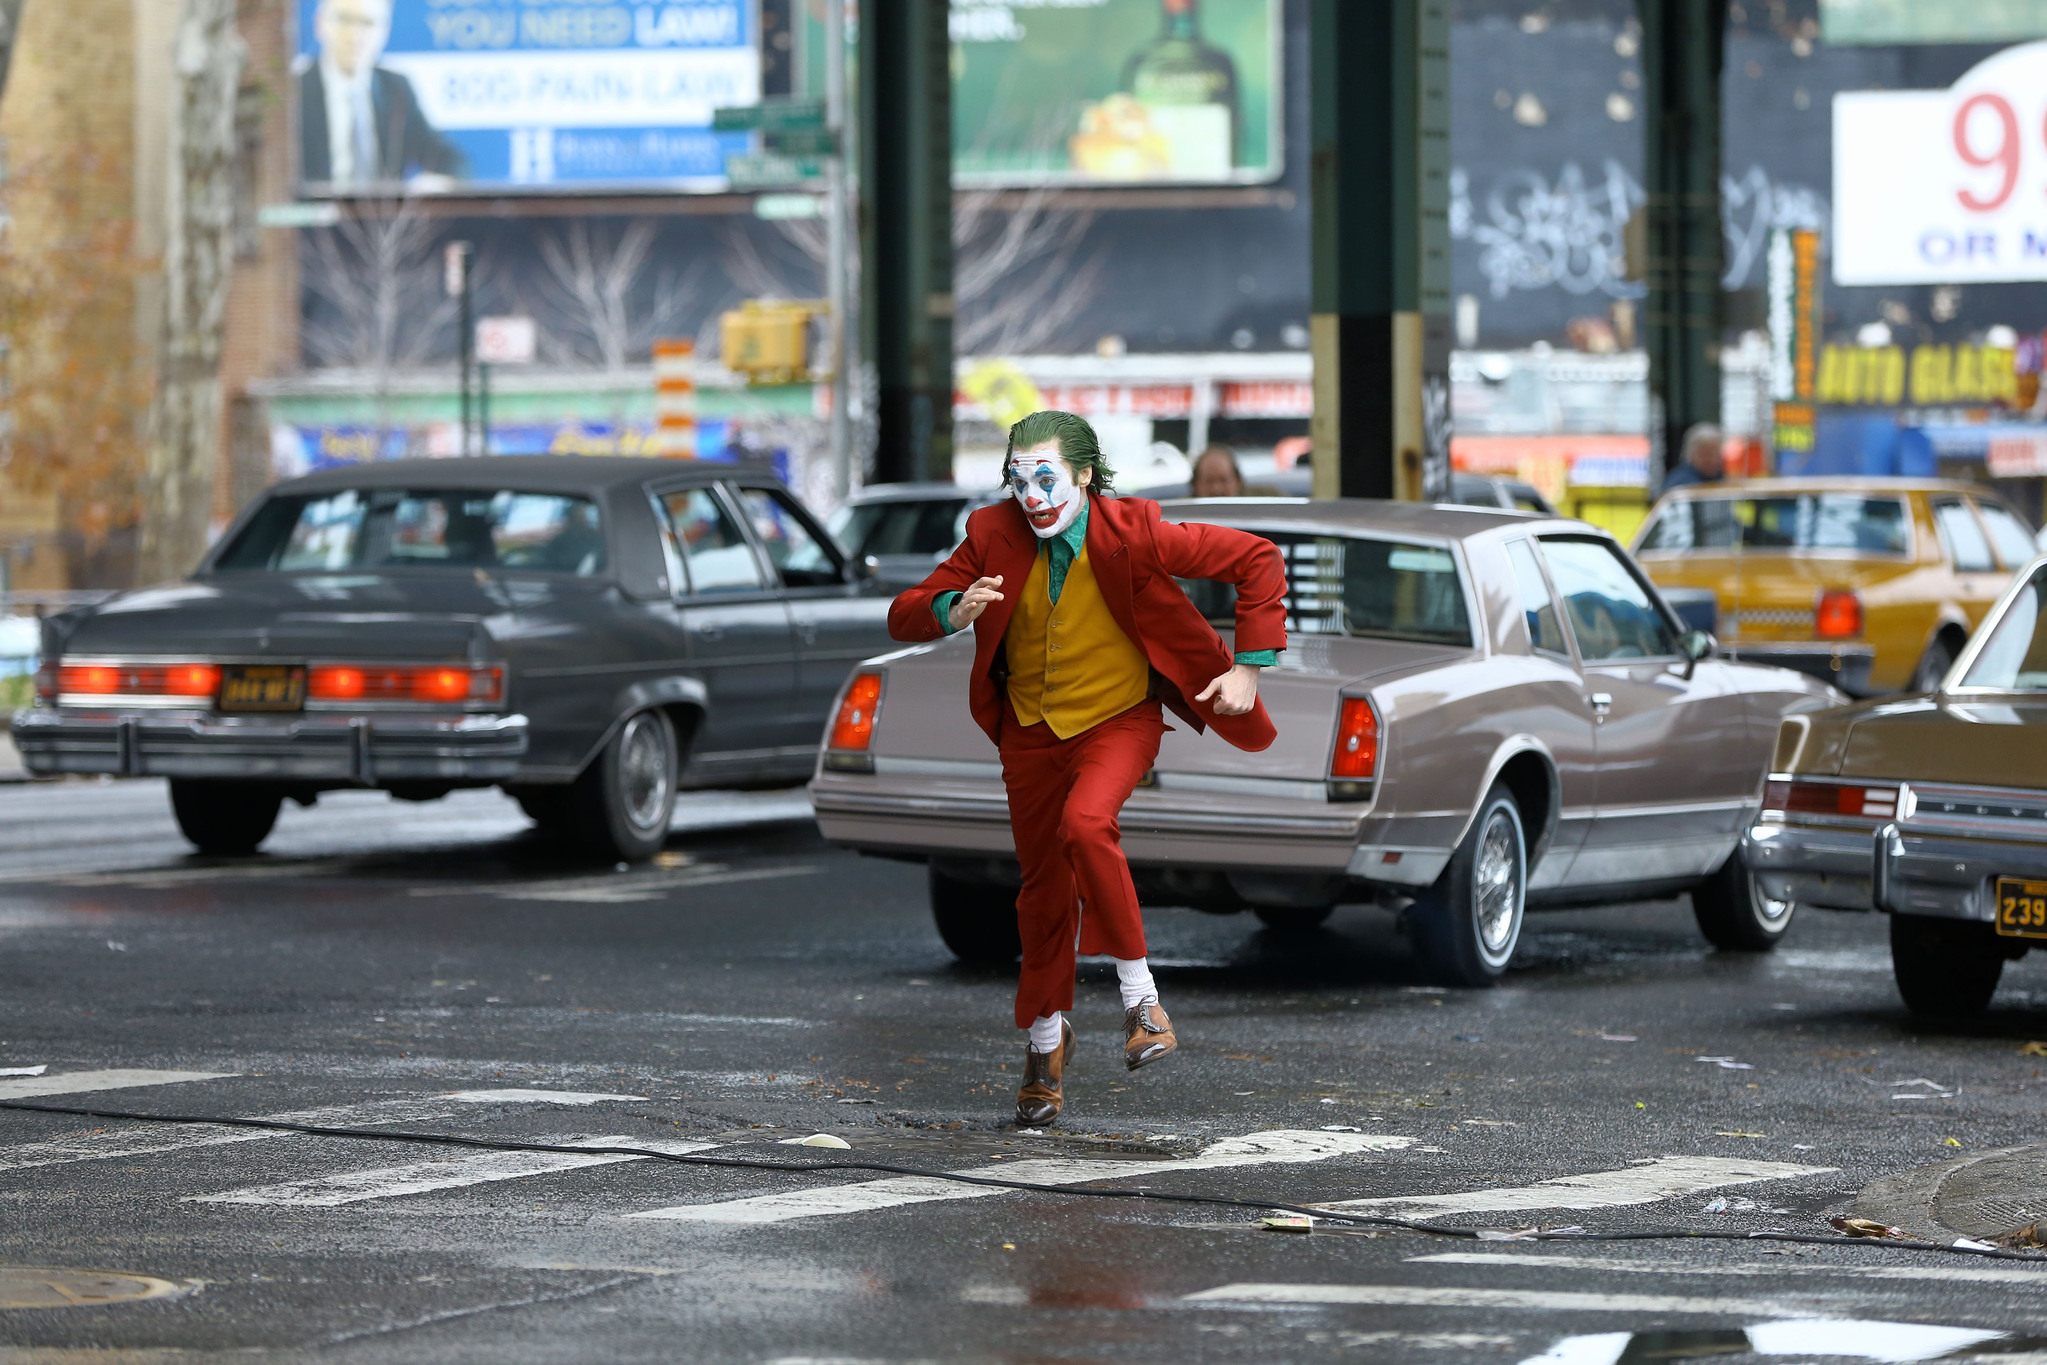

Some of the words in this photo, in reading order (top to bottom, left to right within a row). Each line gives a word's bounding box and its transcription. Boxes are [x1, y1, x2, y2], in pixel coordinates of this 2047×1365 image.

[426, 8, 516, 49] YOU
[519, 6, 631, 46] NEED
[1918, 228, 1997, 266] OR
[1817, 343, 1905, 404] AUTO
[2002, 896, 2046, 927] 239
